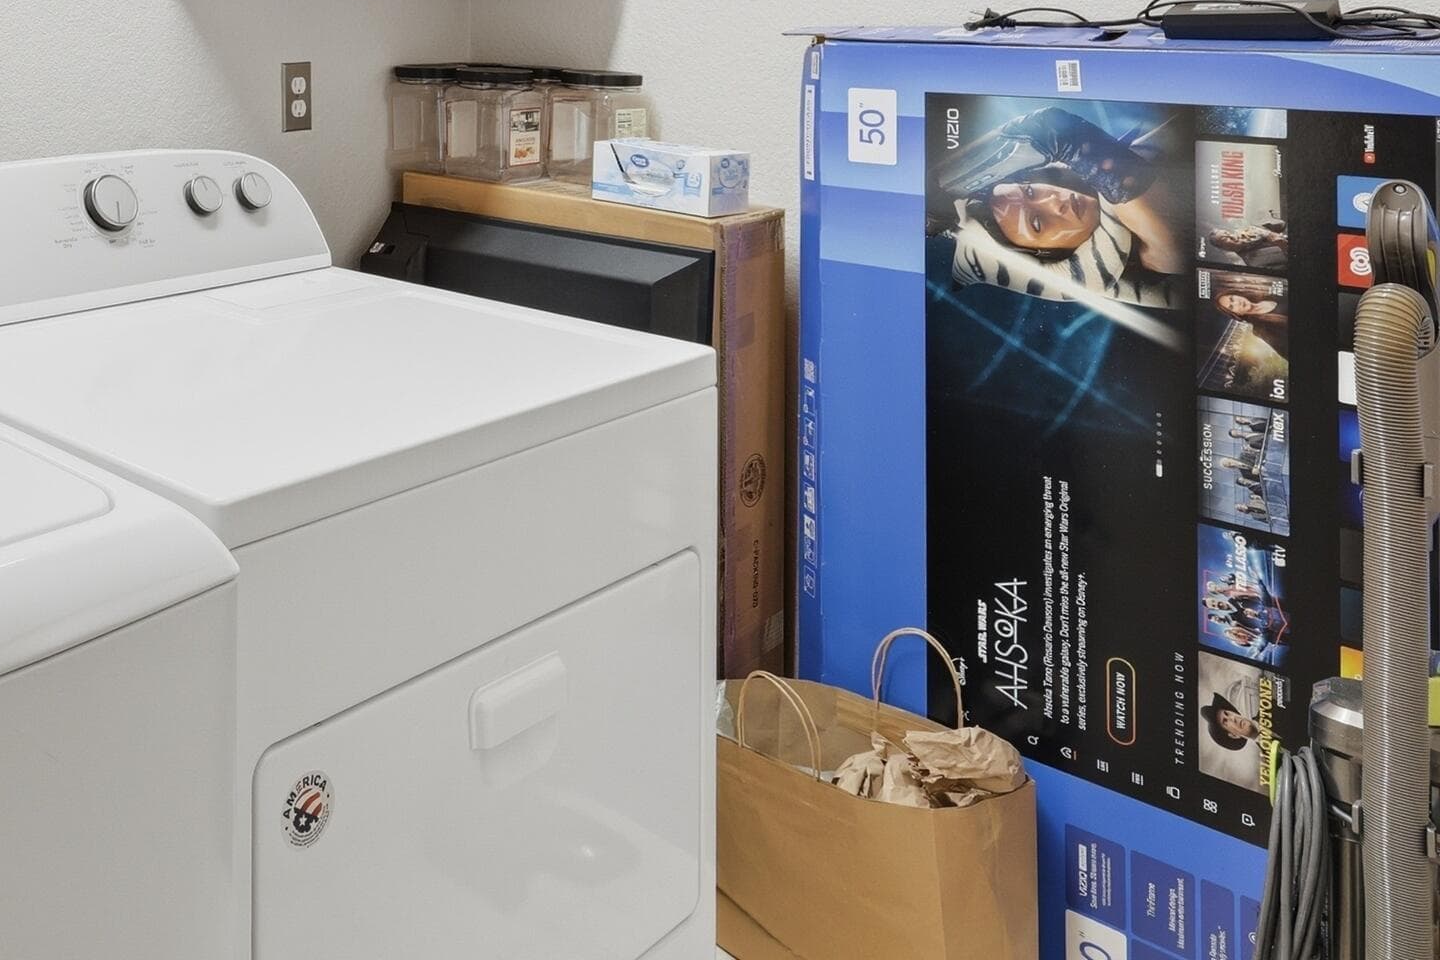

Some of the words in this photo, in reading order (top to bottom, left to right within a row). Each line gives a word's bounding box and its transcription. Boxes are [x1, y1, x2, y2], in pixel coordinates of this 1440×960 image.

[858, 102, 885, 145] 50"
[946, 108, 959, 149] VIZIO
[1221, 150, 1245, 179] KING
[1221, 181, 1245, 219] TULSA
[1269, 378, 1285, 399] ion
[1271, 412, 1286, 441] max
[1202, 423, 1213, 489] SUCCESSION
[1043, 476, 1052, 499] threat
[1058, 480, 1071, 511] Original
[1043, 501, 1054, 537] emerging
[1059, 513, 1069, 532] Wars
[1045, 539, 1052, 549] an
[1059, 533, 1069, 551] Star
[1234, 535, 1247, 571] LASSO
[1043, 550, 1054, 596] investigates
[1060, 582, 1069, 594] the
[1235, 572, 1247, 591] TED
[978, 599, 988, 630] WARS
[978, 631, 988, 663] STAR
[993, 578, 1028, 710] AHSOKA
[1076, 619, 1088, 658] streaming
[1076, 660, 1088, 702] exclusively
[1116, 672, 1126, 694] NOW
[1174, 652, 1185, 682] NOW
[1060, 667, 1070, 706] vulnerable
[1116, 697, 1126, 729] WATCH
[1174, 692, 1185, 764] TRENDING
[1259, 677, 1273, 785] YELLOWSTONE
[283, 774, 327, 819] AMERICA
